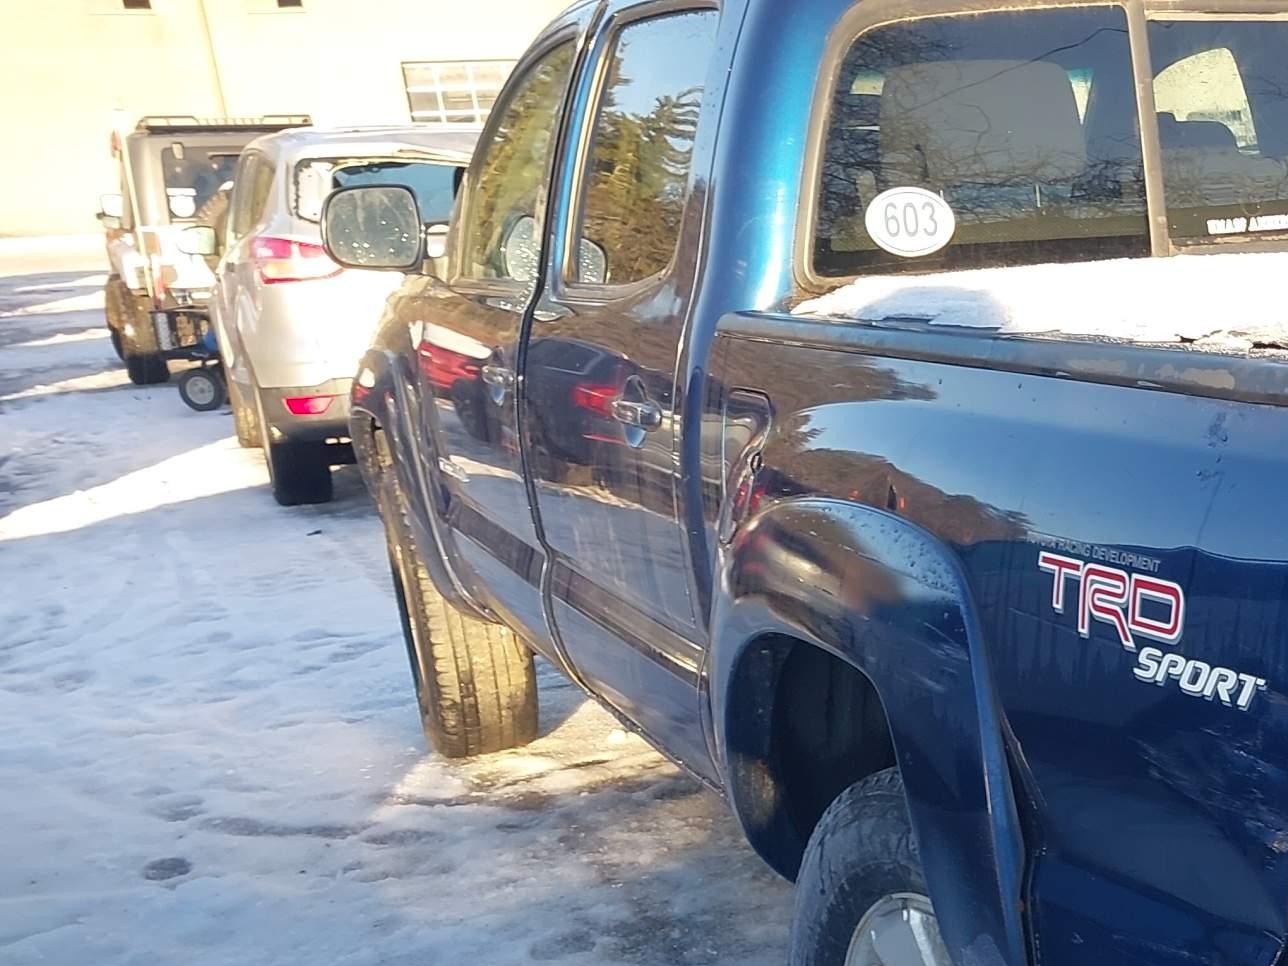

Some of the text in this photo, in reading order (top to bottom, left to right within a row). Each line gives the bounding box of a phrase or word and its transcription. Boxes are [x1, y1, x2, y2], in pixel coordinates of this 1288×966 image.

[884, 202, 938, 237] 603
[1092, 546, 1161, 573] DEVELOPMENT
[1038, 551, 1184, 653] TRD
[1133, 647, 1268, 711] SPORT
